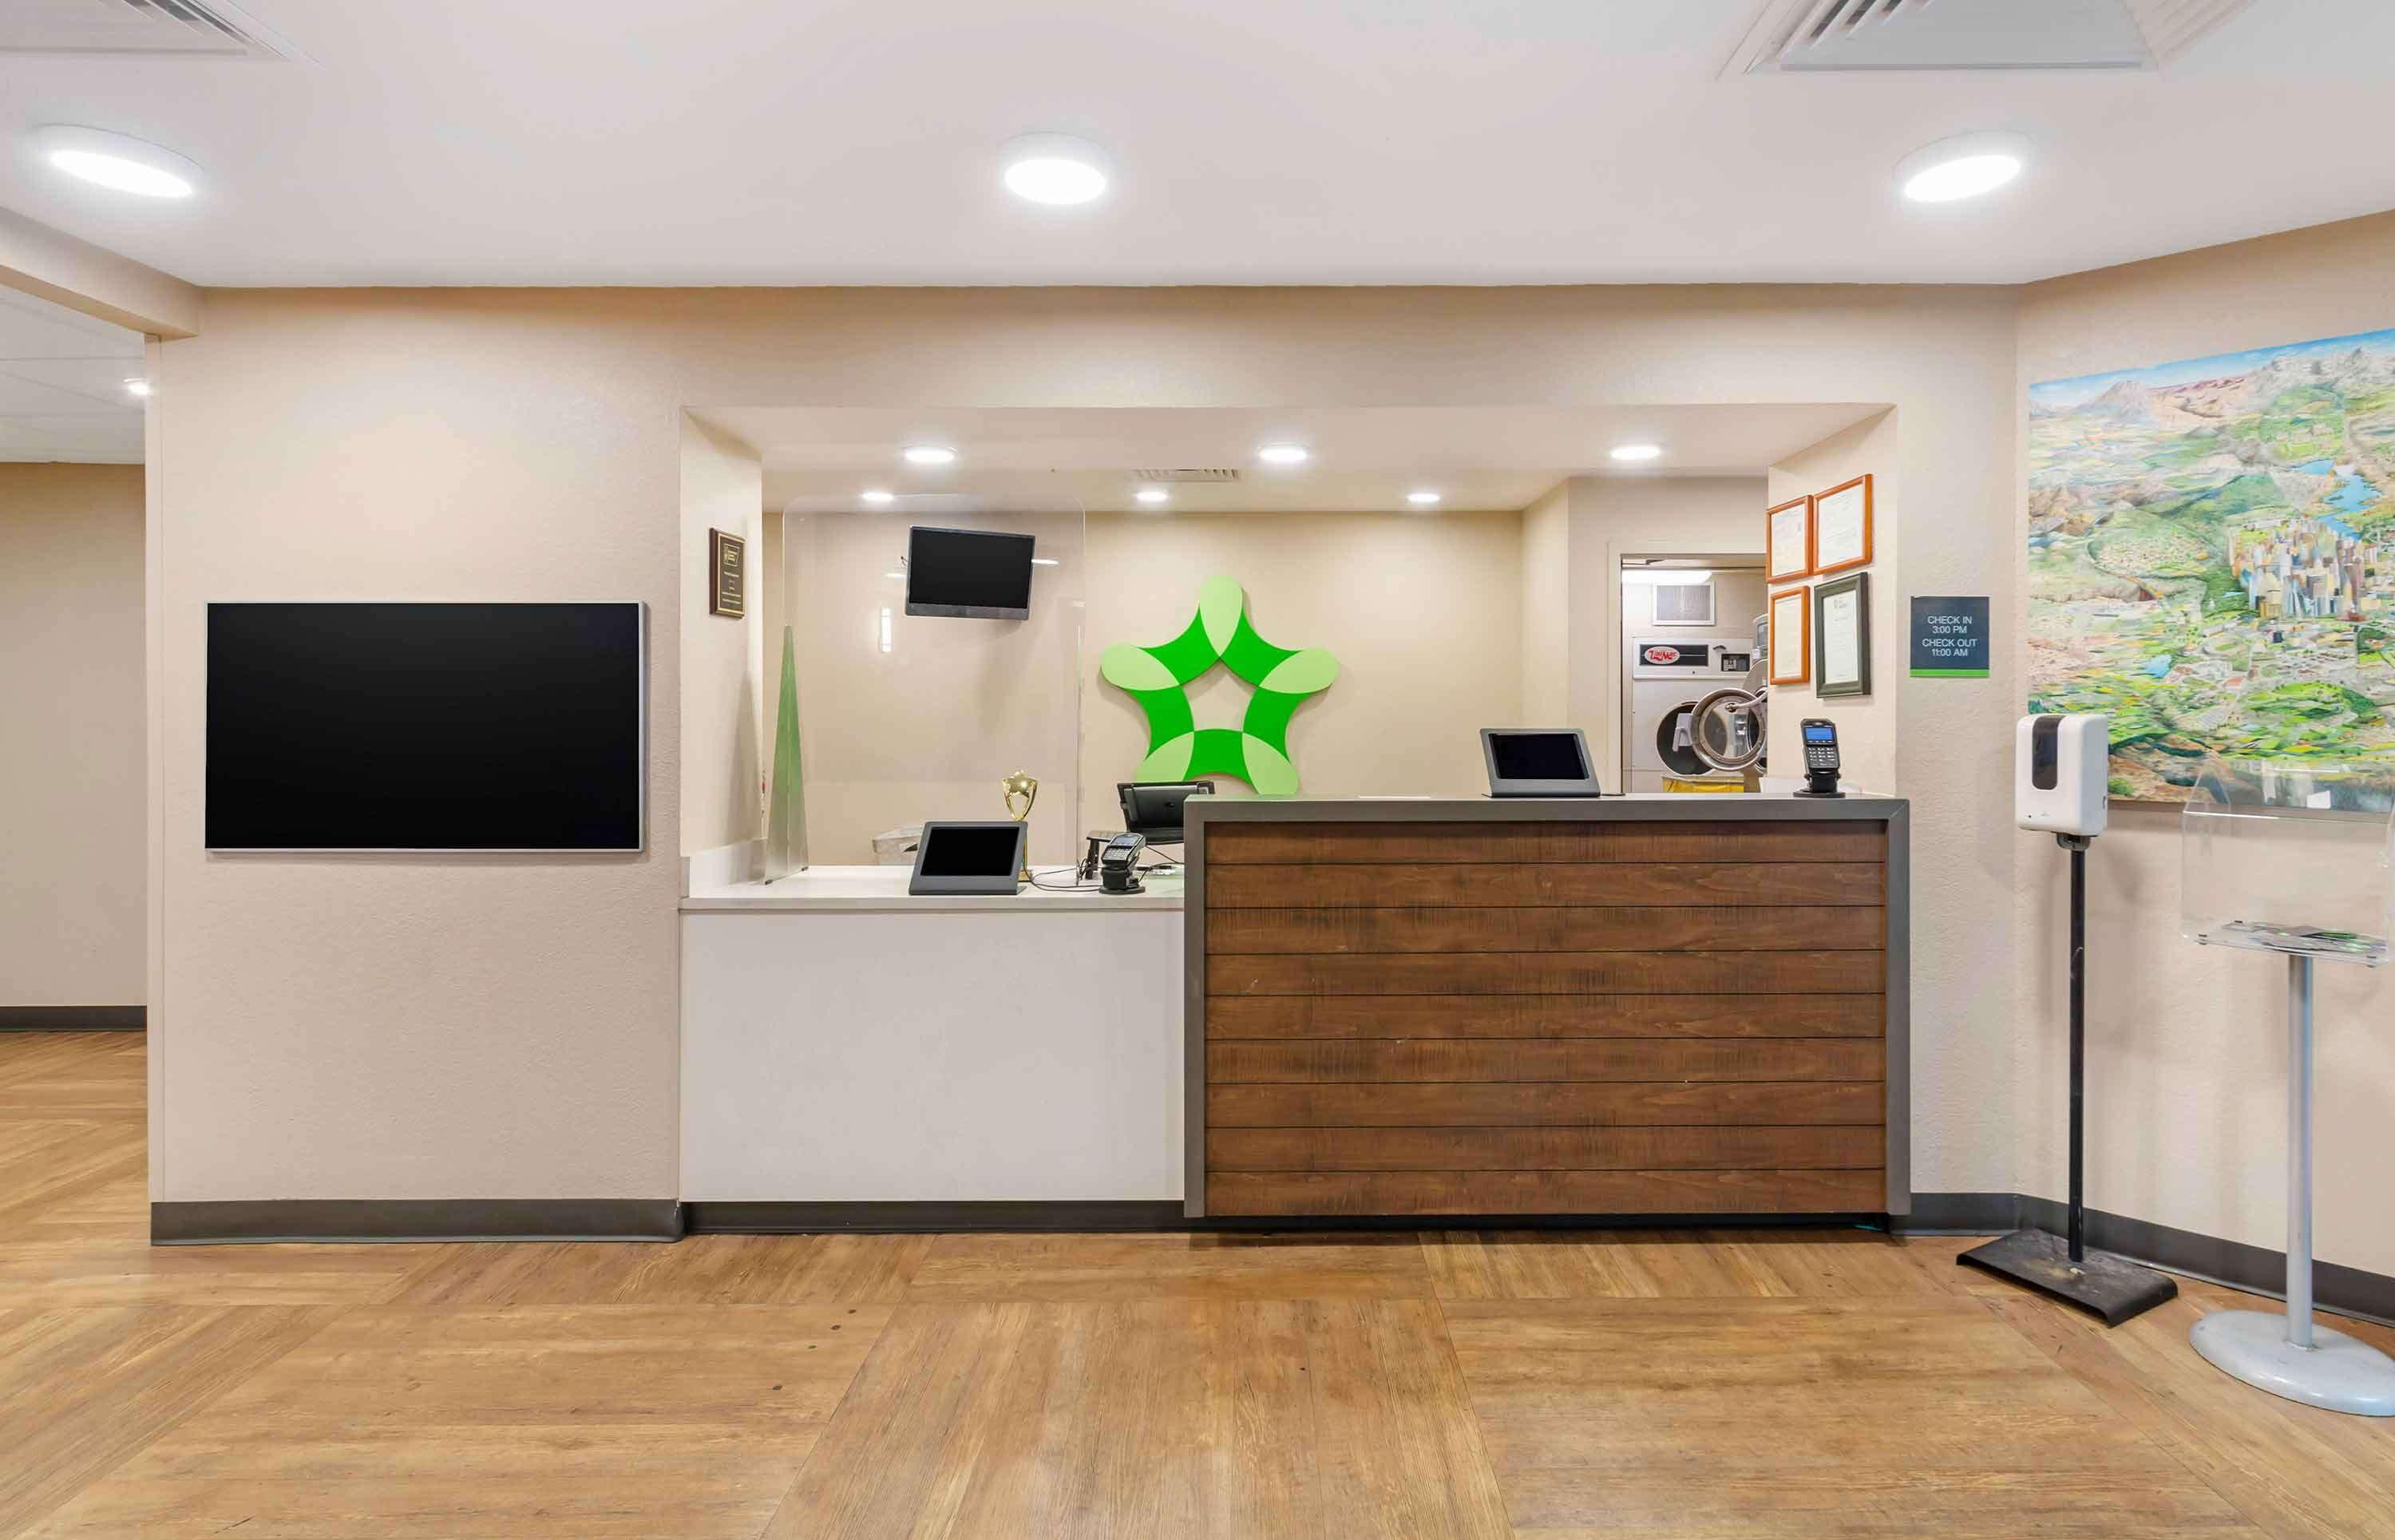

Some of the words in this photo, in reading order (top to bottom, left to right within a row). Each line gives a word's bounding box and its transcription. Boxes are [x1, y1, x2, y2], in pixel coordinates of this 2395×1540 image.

[1927, 616, 1961, 624] CHECK
[1962, 616, 1972, 624] IN
[1922, 638, 1954, 647] CHECK
[1957, 638, 1977, 647] OUT
